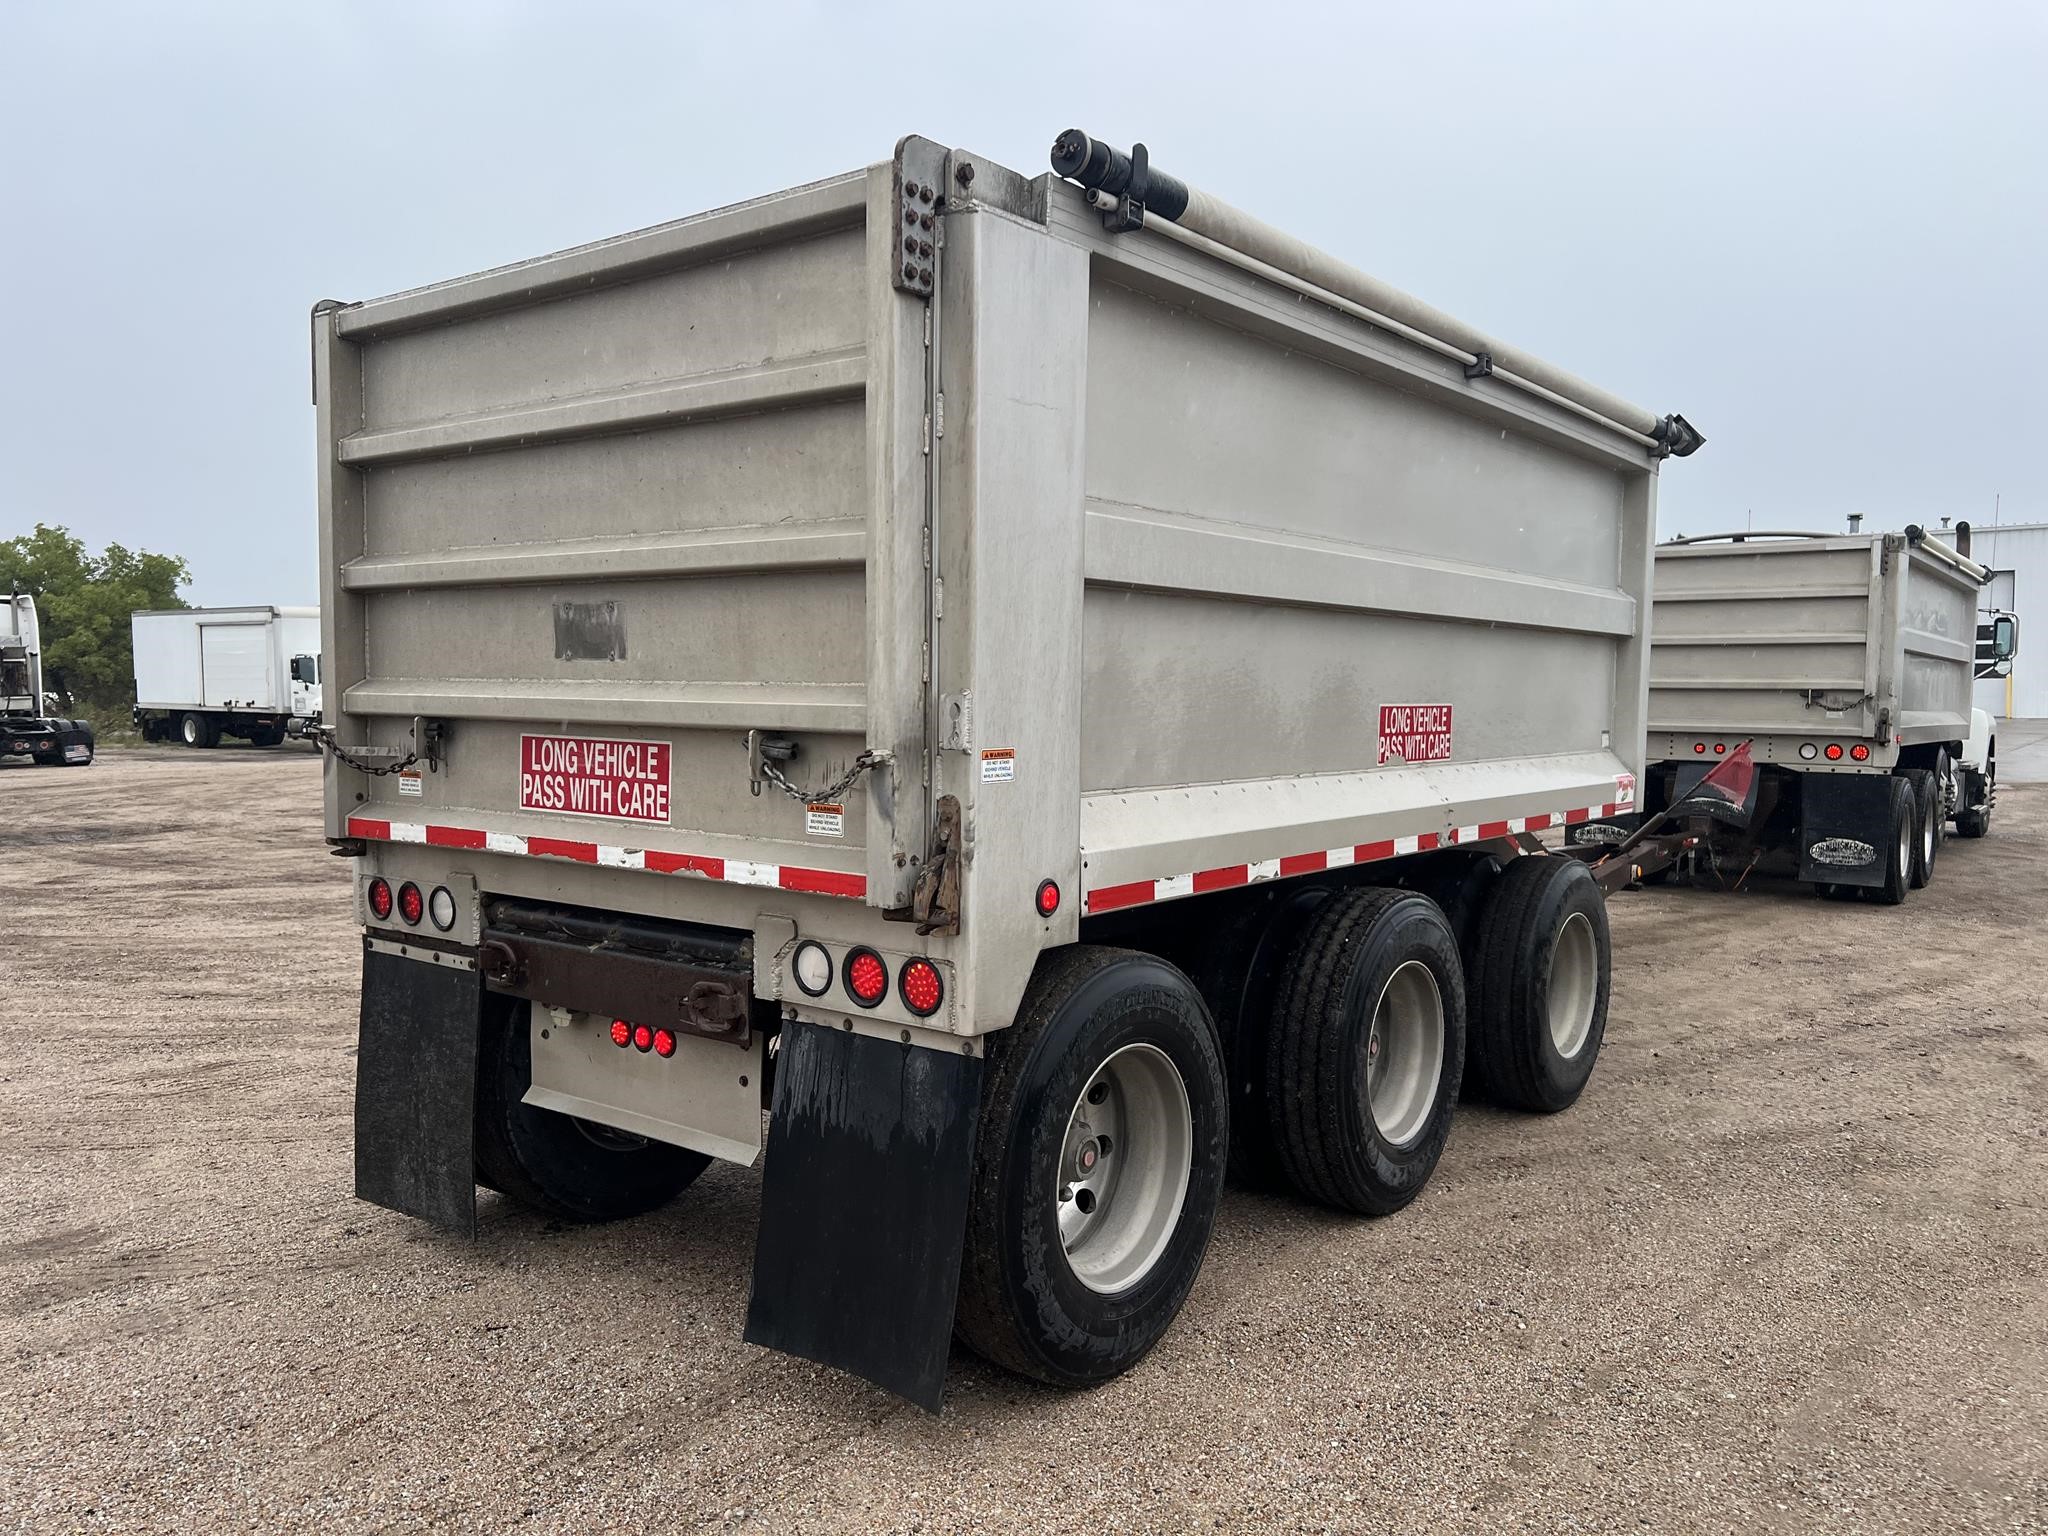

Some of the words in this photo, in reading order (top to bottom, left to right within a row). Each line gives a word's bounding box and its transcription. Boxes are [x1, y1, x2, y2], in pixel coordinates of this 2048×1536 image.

[1385, 707, 1411, 734] LONG
[1412, 707, 1448, 733] VEHICLE
[531, 739, 578, 774] LONG
[583, 742, 659, 780] VEHICLE
[1379, 735, 1403, 762] PASS
[1405, 735, 1427, 760] WITH
[1428, 734, 1451, 759] CARE
[522, 773, 565, 809] PASS
[569, 777, 612, 813] WITH
[617, 780, 668, 818] CARE
